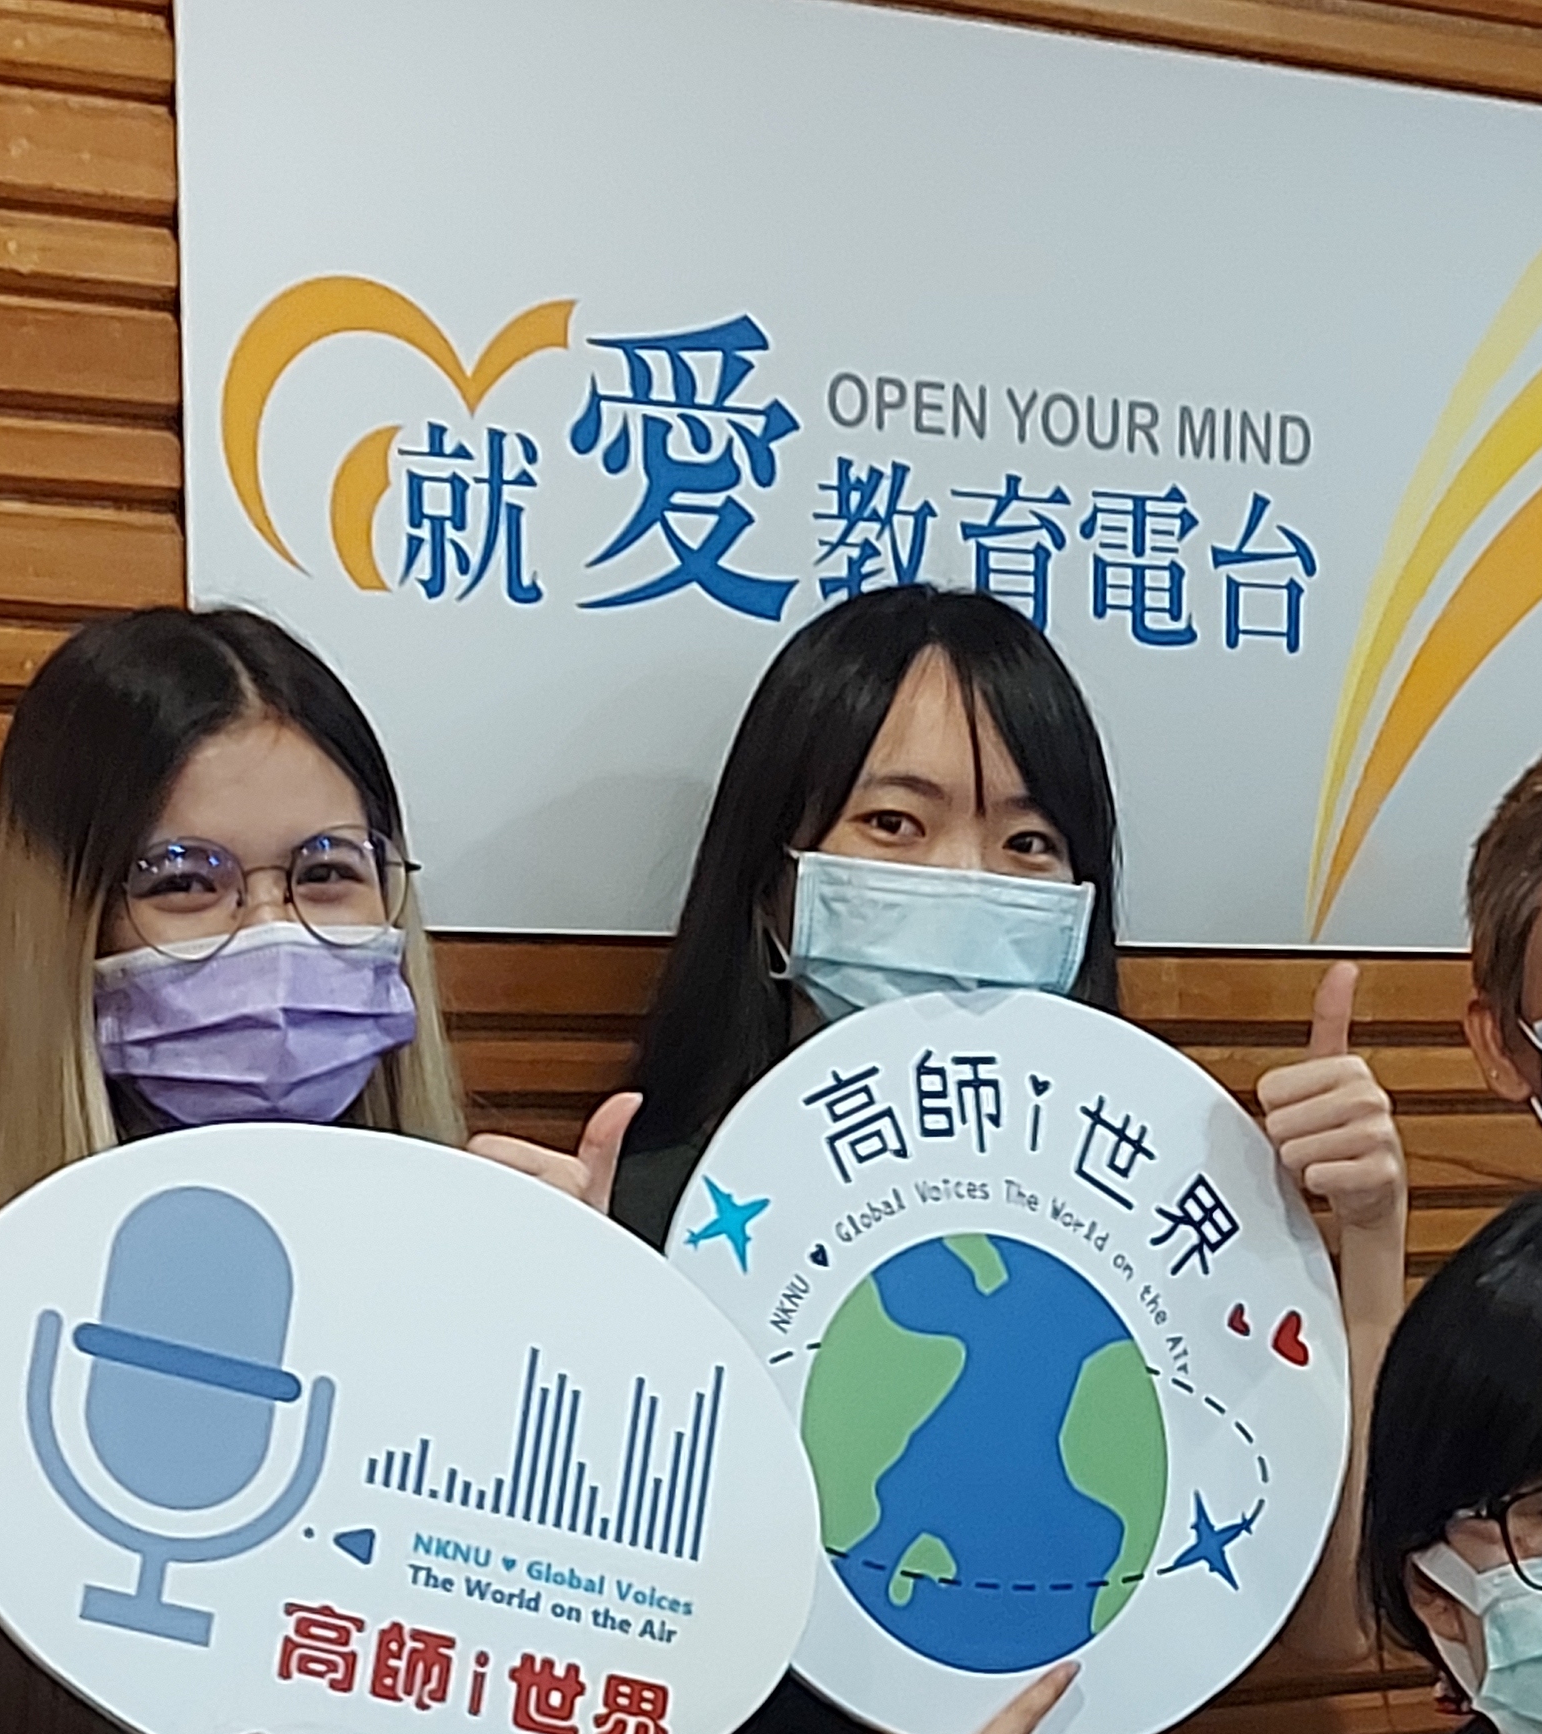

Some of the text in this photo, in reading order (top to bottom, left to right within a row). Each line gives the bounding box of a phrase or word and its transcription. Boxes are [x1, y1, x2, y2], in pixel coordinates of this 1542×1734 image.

[827, 371, 1315, 468] OPEN YOUR MIND
[769, 1275, 810, 1334] NKNU
[835, 1188, 906, 1245] Global
[915, 1179, 990, 1204] Voices
[1004, 1180, 1038, 1212] The
[1049, 1198, 1109, 1253] World
[1112, 1251, 1135, 1282] on
[1139, 1283, 1168, 1327] the
[407, 1563, 679, 1645] The World on the Air
[412, 1532, 694, 1618] NKNU Global Voices
